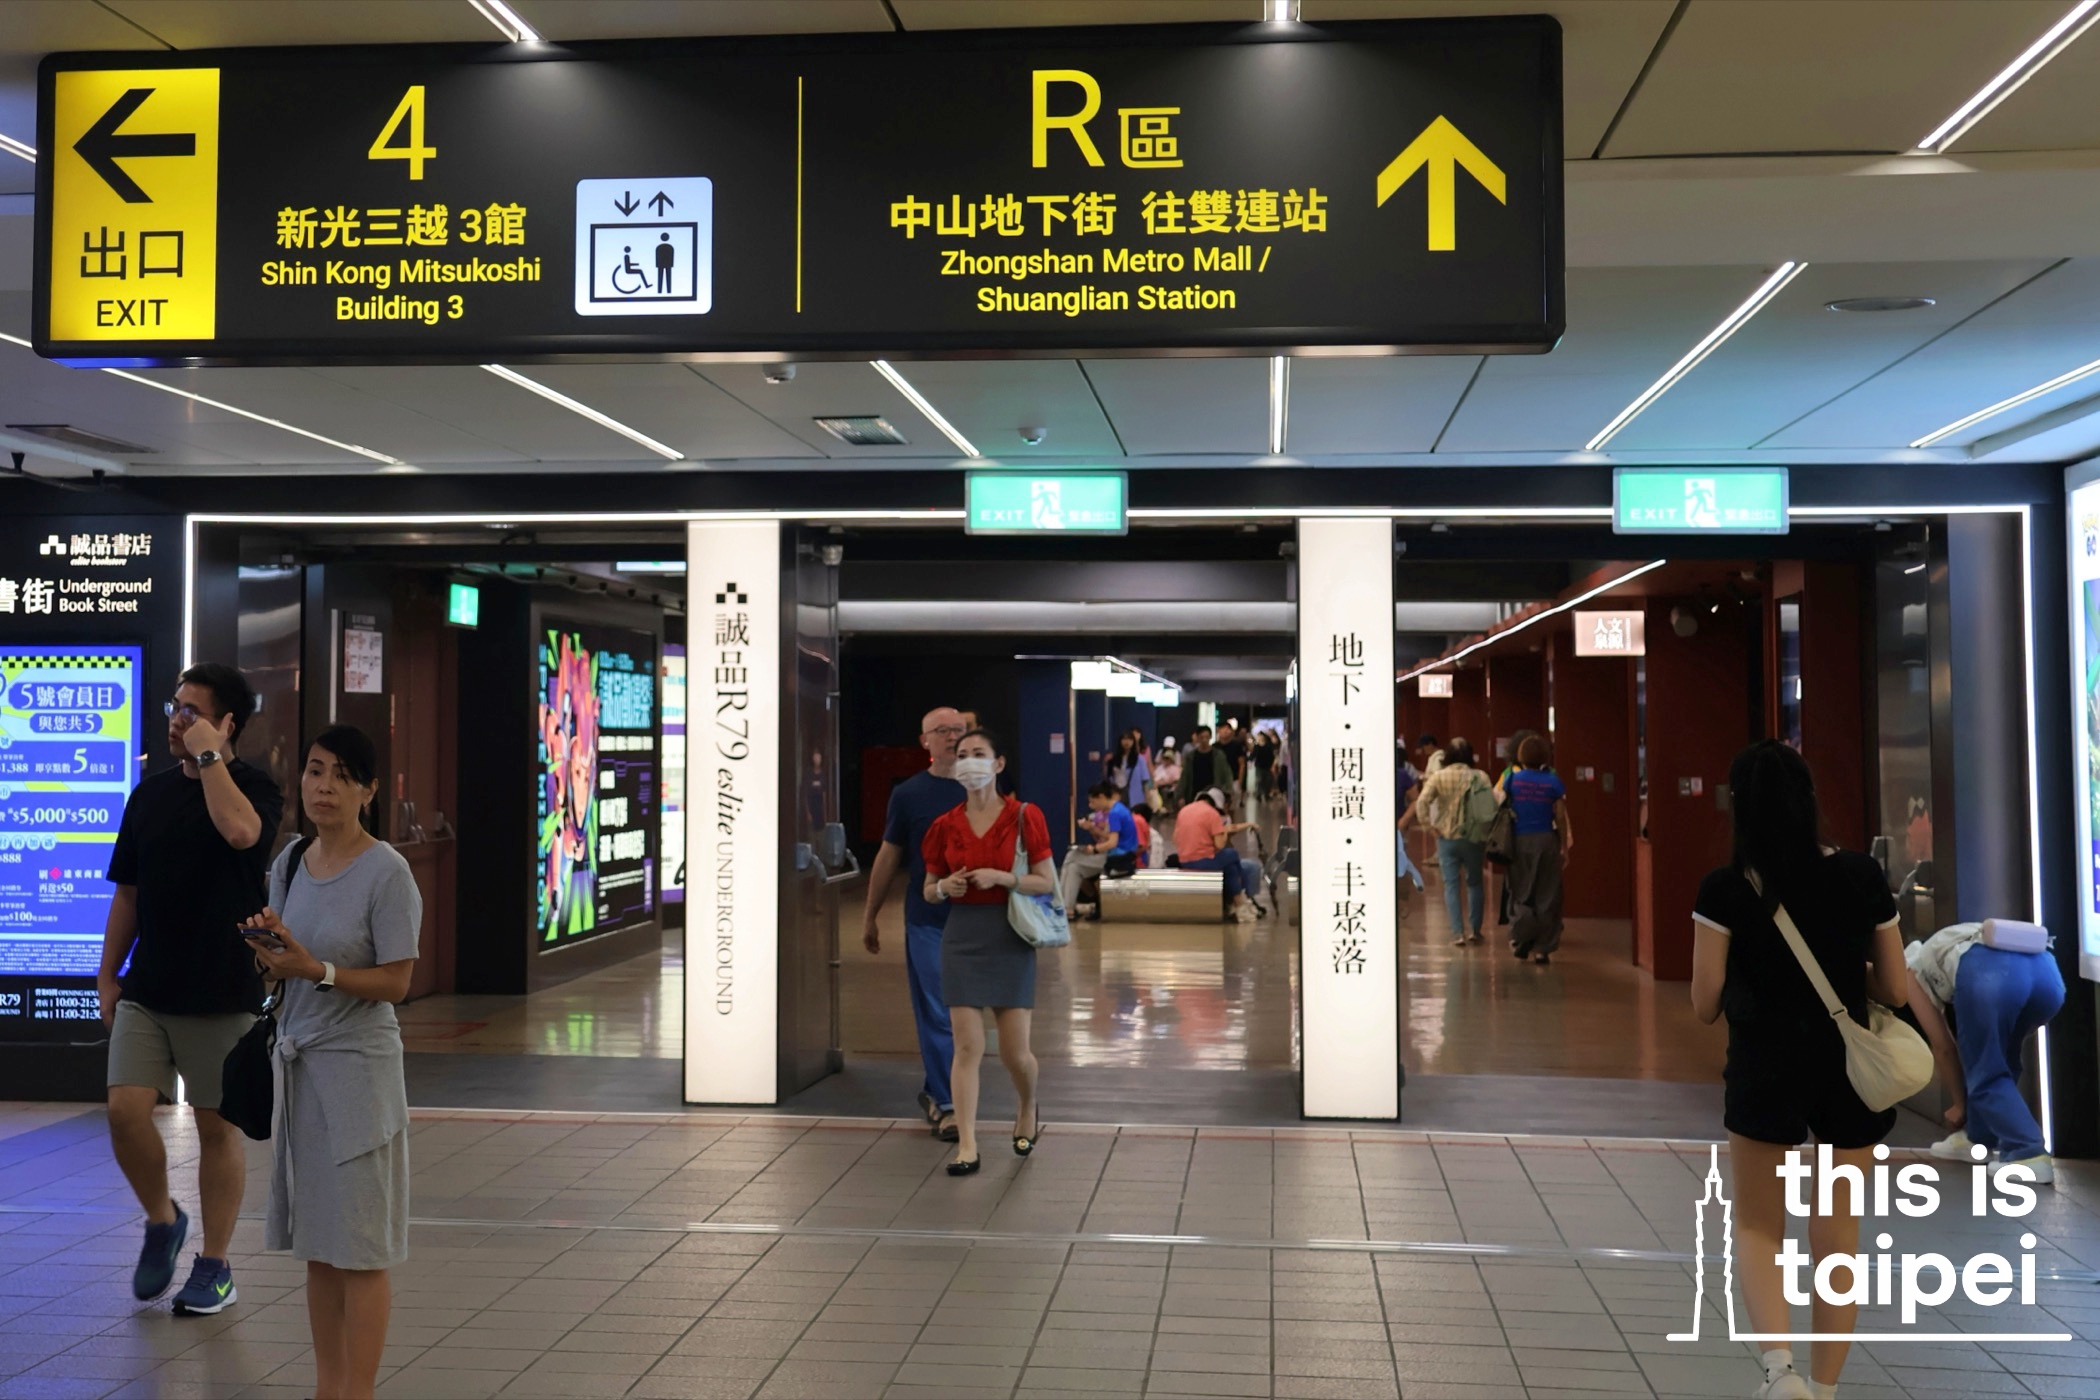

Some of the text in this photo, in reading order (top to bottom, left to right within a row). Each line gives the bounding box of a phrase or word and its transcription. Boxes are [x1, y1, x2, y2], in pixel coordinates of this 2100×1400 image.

[368, 85, 437, 180] 4
[1032, 69, 1184, 168] R 區
[276, 203, 527, 249] 新光三越 3館
[890, 188, 1328, 239] 中山地下街 往雙連站
[80, 227, 184, 280] 出口
[940, 250, 1094, 281] Zhongshan
[1103, 249, 1185, 273] Metro
[1193, 245, 1252, 272] Mall
[261, 256, 541, 290] Shin Kong Mitsukoshi
[96, 299, 169, 327] EXIT
[336, 294, 464, 326] Building 3
[976, 284, 1236, 318] Shuanglian Station
[980, 510, 1024, 521] EXIT
[1630, 508, 1677, 520] EXIT
[70, 533, 152, 556] 誠品書店
[59, 578, 152, 598] Underground
[59, 597, 138, 613] Book Street
[20, 684, 113, 709] 5號會員日
[38, 713, 95, 732] 與您共5
[0, 762, 29, 774] 1,388
[716, 767, 744, 836] eslite
[716, 841, 734, 1016] UNDERGROUND
